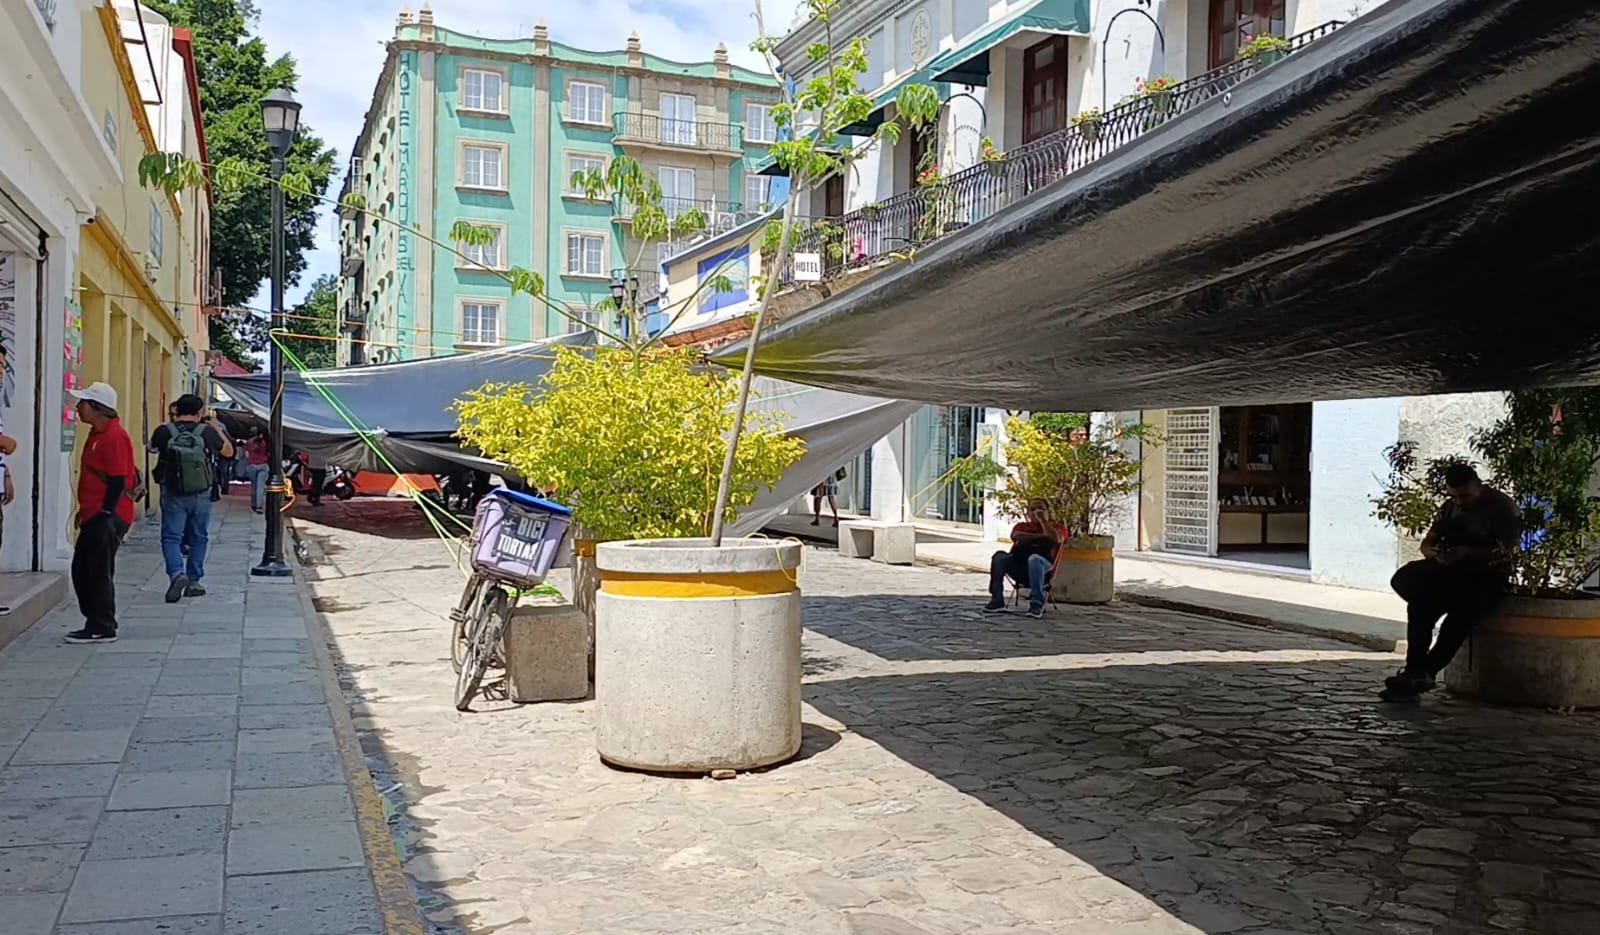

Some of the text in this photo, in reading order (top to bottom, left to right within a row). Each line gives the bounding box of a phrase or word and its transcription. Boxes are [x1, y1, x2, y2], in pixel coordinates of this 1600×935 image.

[399, 53, 411, 146] HOTEL
[795, 261, 819, 272] HOTEL
[517, 516, 547, 540] BICI
